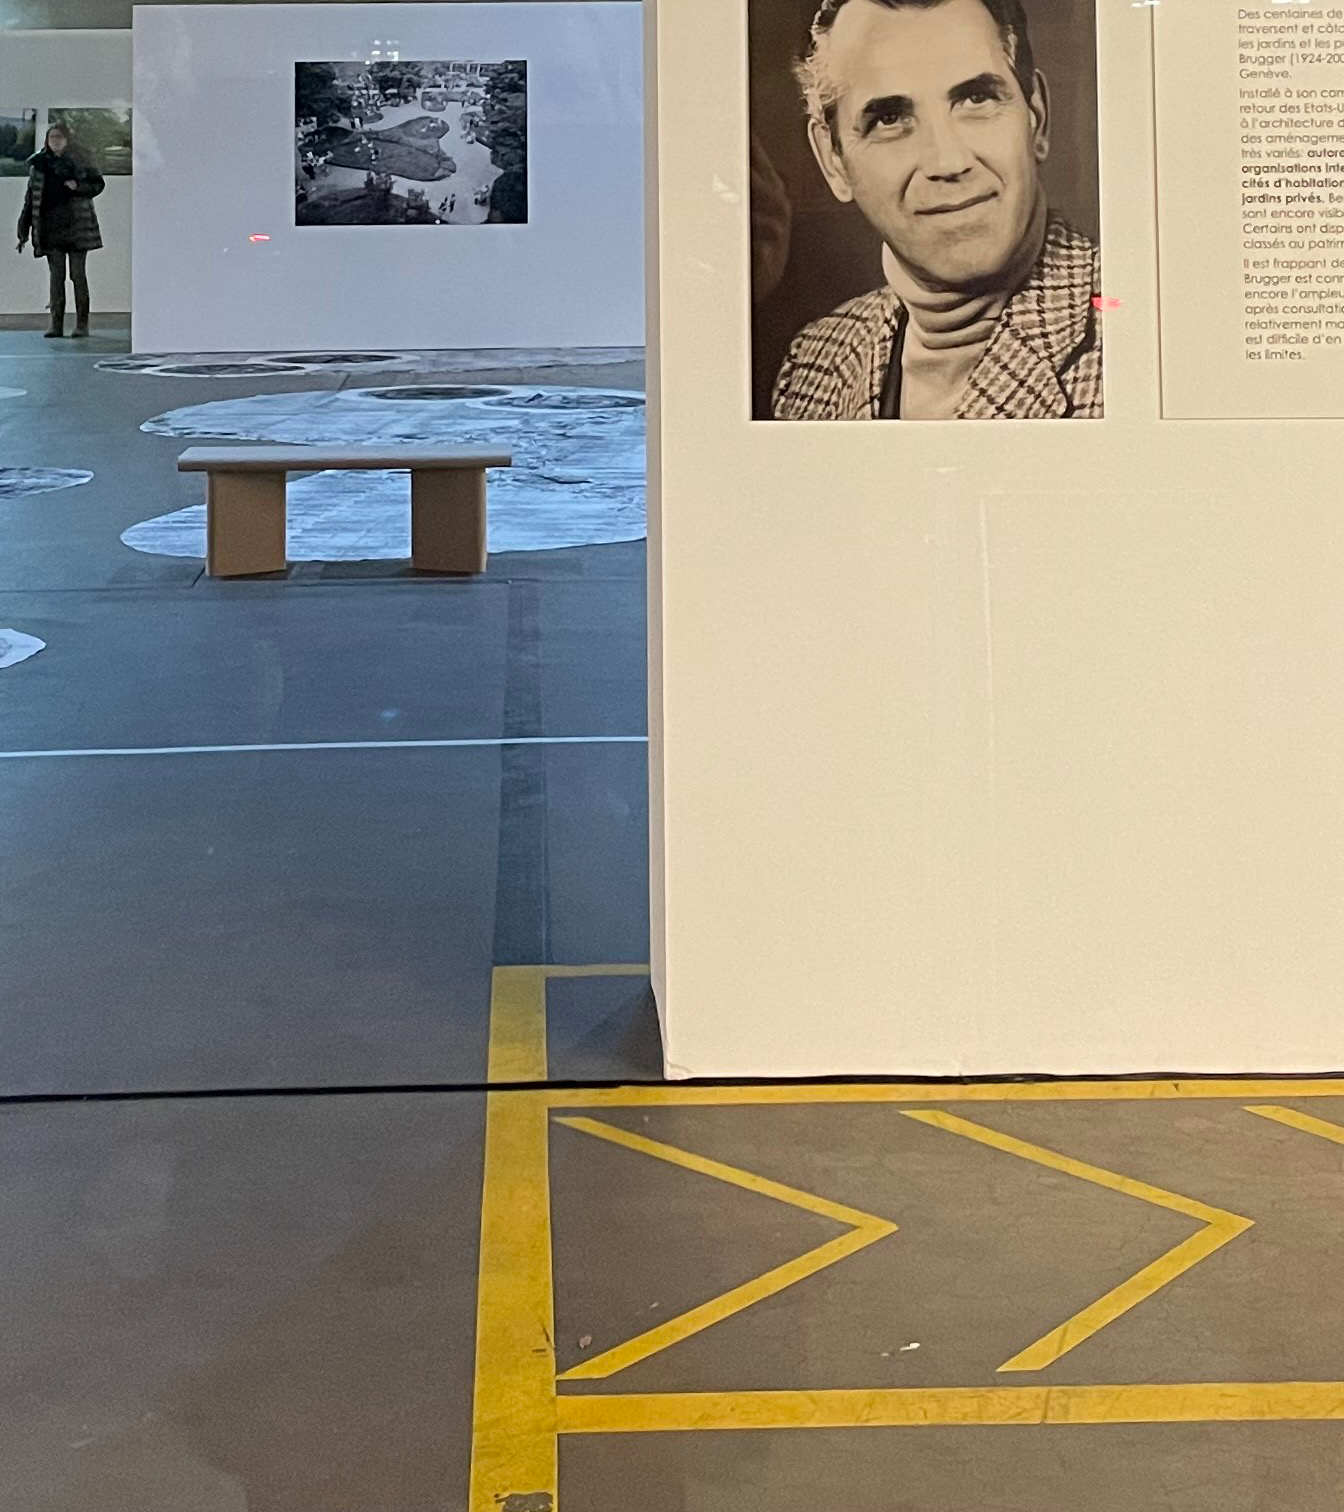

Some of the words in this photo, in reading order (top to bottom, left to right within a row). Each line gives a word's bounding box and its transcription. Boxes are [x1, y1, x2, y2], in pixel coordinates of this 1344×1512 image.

[1238, 6, 1261, 19] Des
[1327, 6, 1343, 19] de
[1238, 21, 1299, 34] traversent
[1302, 21, 1315, 34] et
[1256, 37, 1297, 51] jardins
[1299, 36, 1312, 49] et
[1239, 52, 1287, 66] Brugger
[1296, 88, 1318, 99] son
[1240, 101, 1277, 114] retour
[1279, 101, 1301, 114] des
[1241, 131, 1263, 144] des
[1242, 147, 1262, 159] très
[1242, 162, 1322, 176] organisations
[1242, 177, 1270, 189] cités
[1241, 192, 1282, 206] jardins
[1242, 207, 1267, 219] sont
[1271, 209, 1316, 219] encore
[1243, 222, 1293, 234] Certains
[1297, 222, 1317, 234] ont
[1243, 237, 1286, 250] classés
[1288, 240, 1305, 250] au
[1253, 257, 1270, 269] est
[1273, 257, 1327, 271] frappant
[1244, 272, 1293, 286] Brugger
[1295, 272, 1313, 285] est
[1245, 290, 1289, 300] encore
[1245, 303, 1280, 317] après
[1245, 318, 1323, 330] relativement
[1246, 333, 1263, 345] est
[1244, 347, 1262, 361] les
